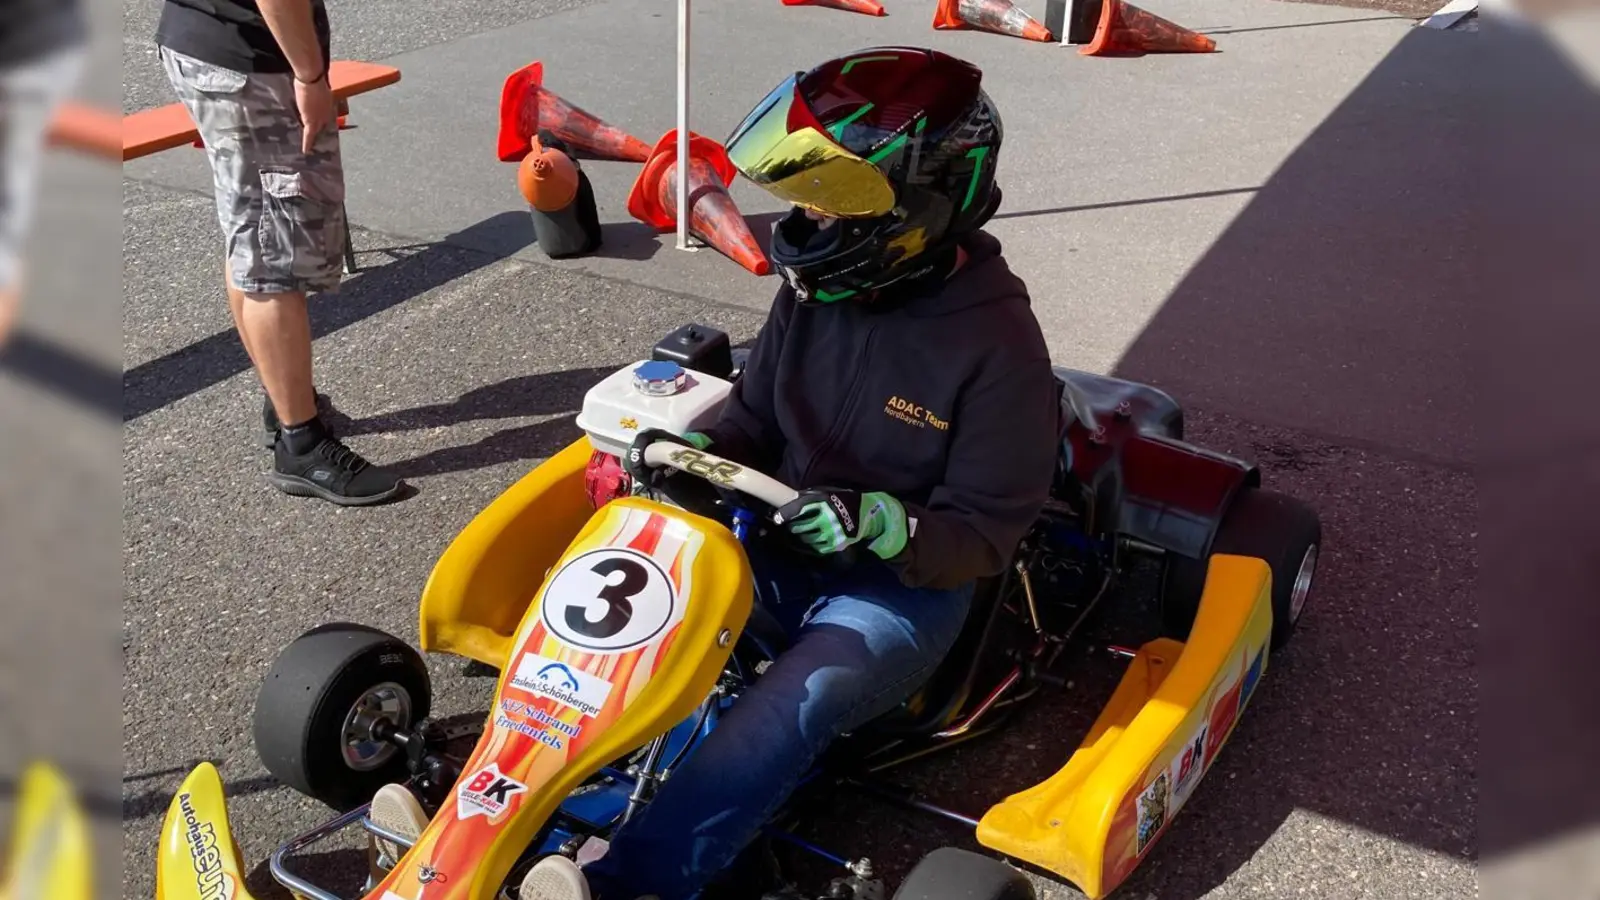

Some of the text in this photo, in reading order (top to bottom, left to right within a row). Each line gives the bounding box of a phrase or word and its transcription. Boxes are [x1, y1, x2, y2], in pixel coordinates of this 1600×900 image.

[884, 406, 925, 428] Nordbayern
[887, 395, 949, 430] ADAC Team
[564, 557, 648, 638] 3
[496, 715, 563, 750] Friedenfels
[525, 705, 581, 738] Schraml
[467, 771, 521, 804] BK
[179, 793, 206, 857] Autohaus
